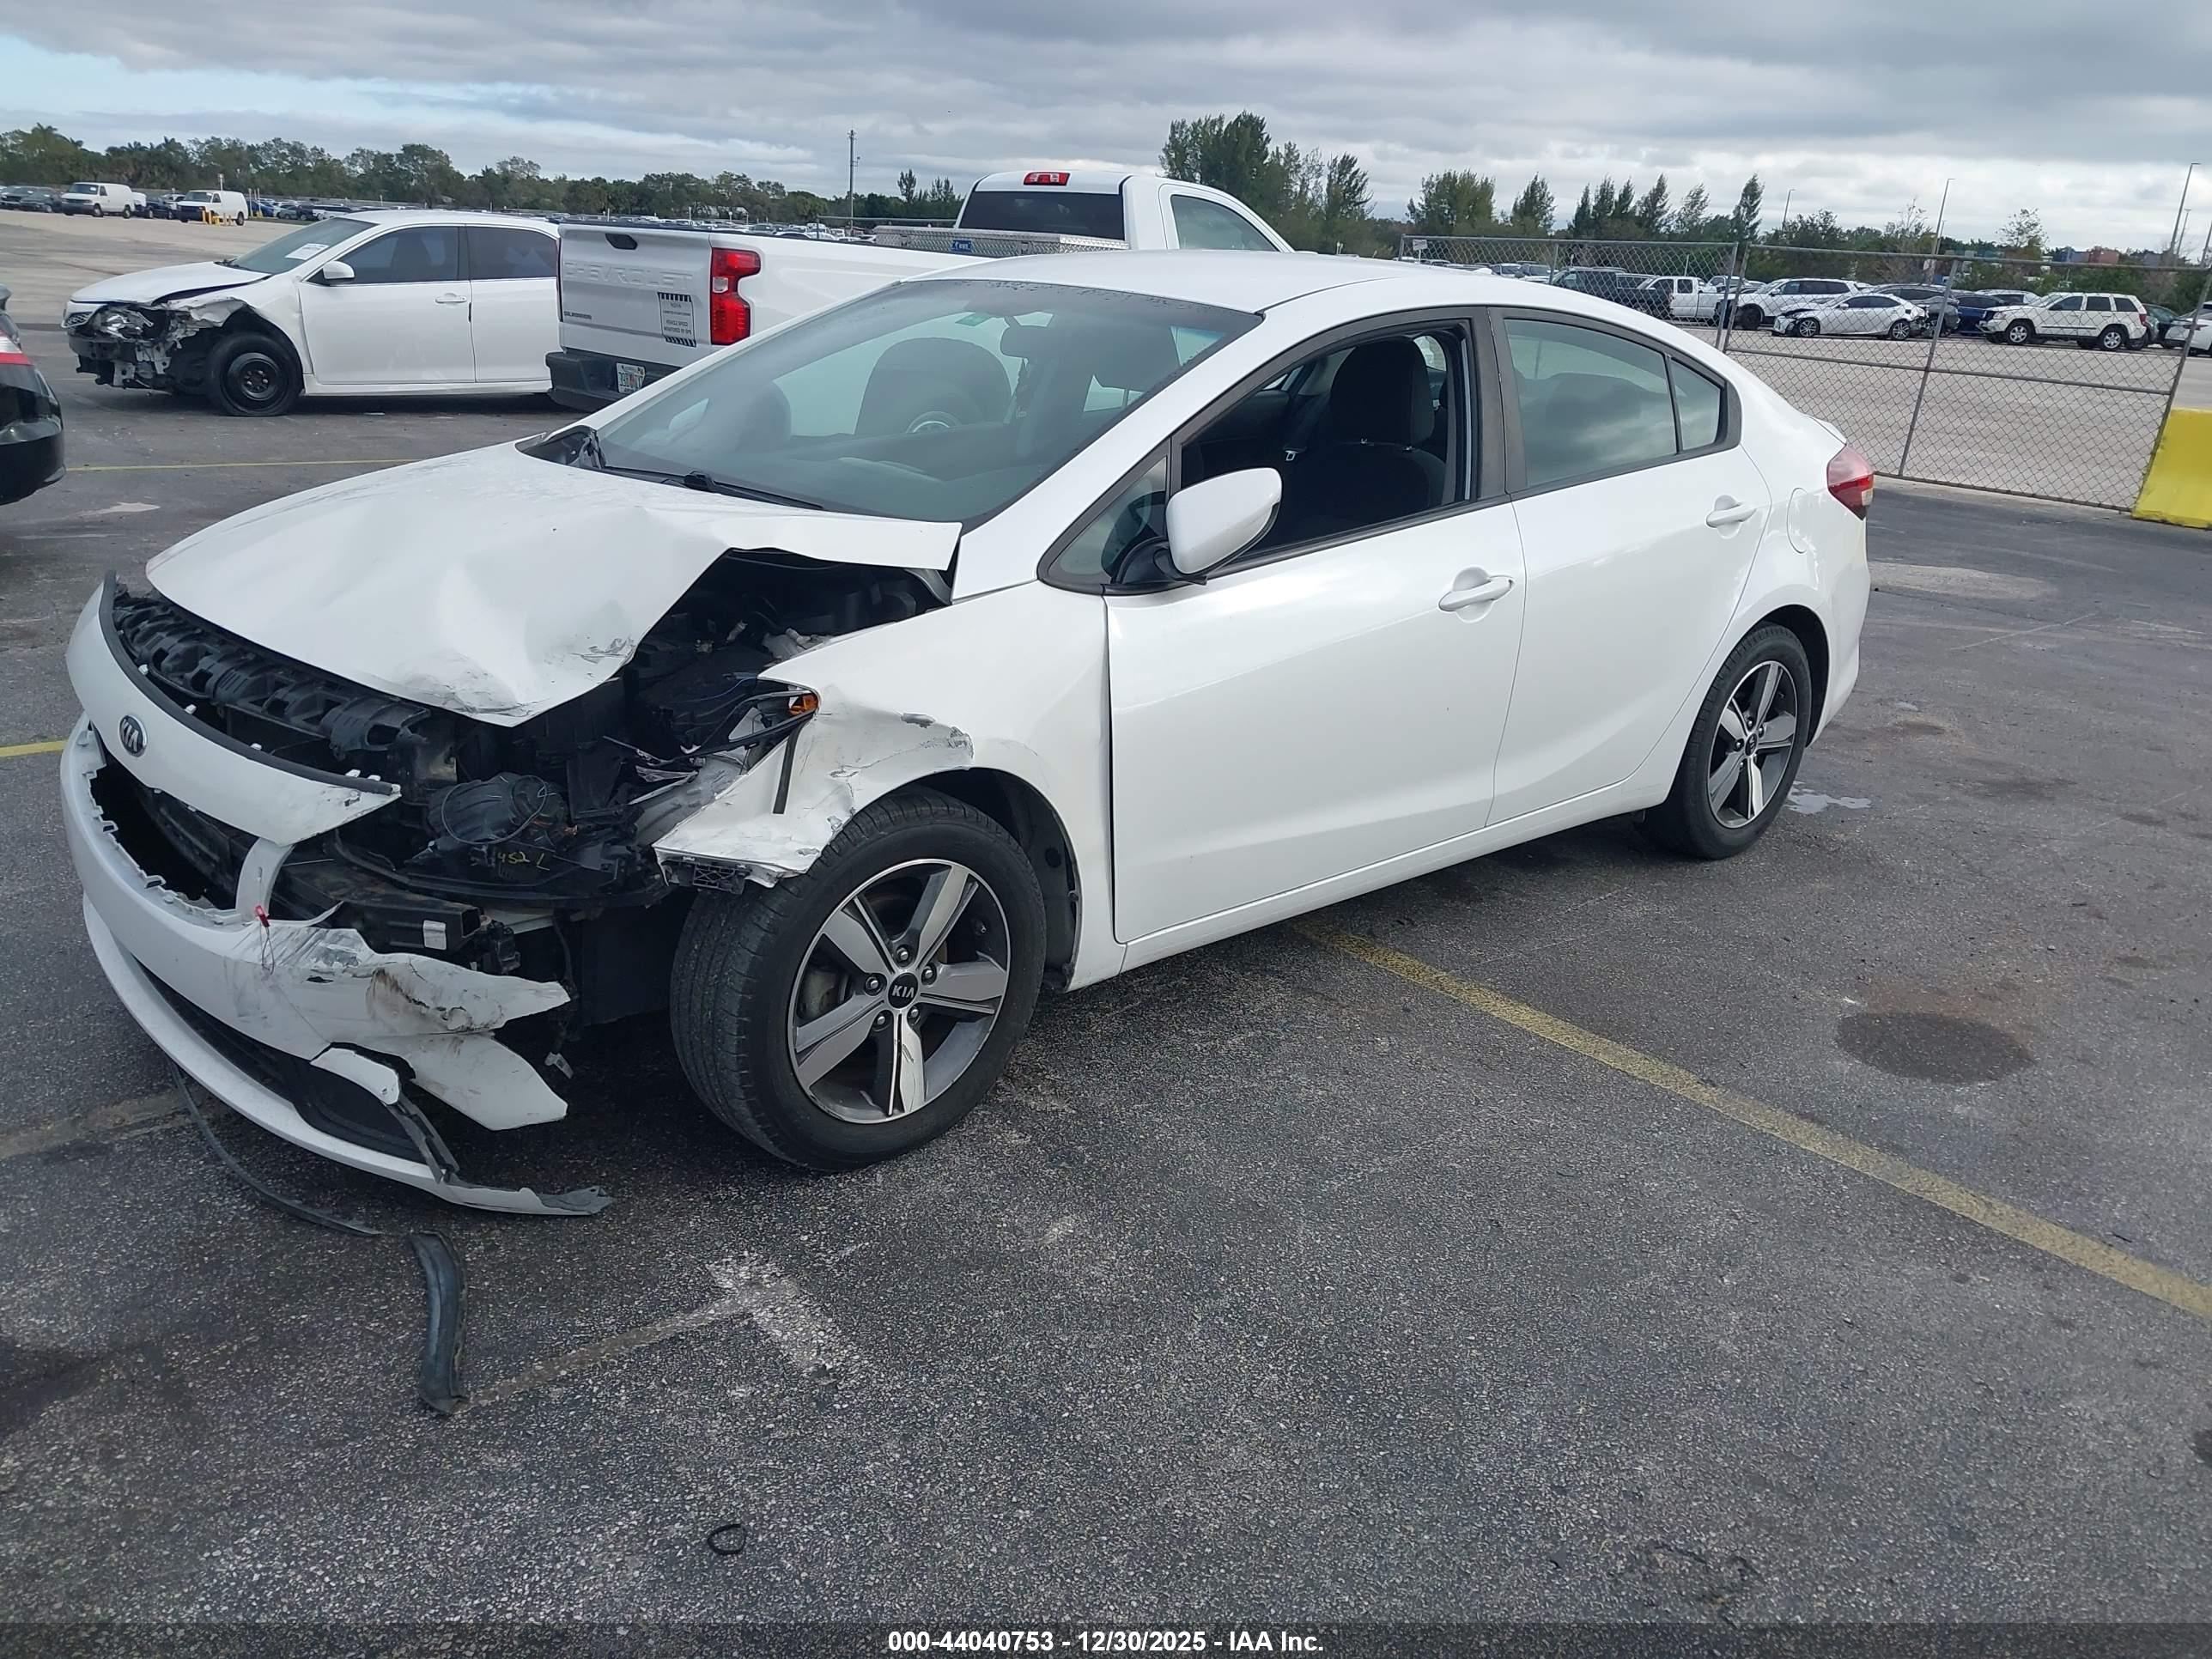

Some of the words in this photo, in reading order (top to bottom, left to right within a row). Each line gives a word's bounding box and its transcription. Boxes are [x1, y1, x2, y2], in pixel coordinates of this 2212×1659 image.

[564, 260, 694, 289] CHEVROLET
[119, 718, 139, 752] KIA
[891, 984, 915, 999] KIA
